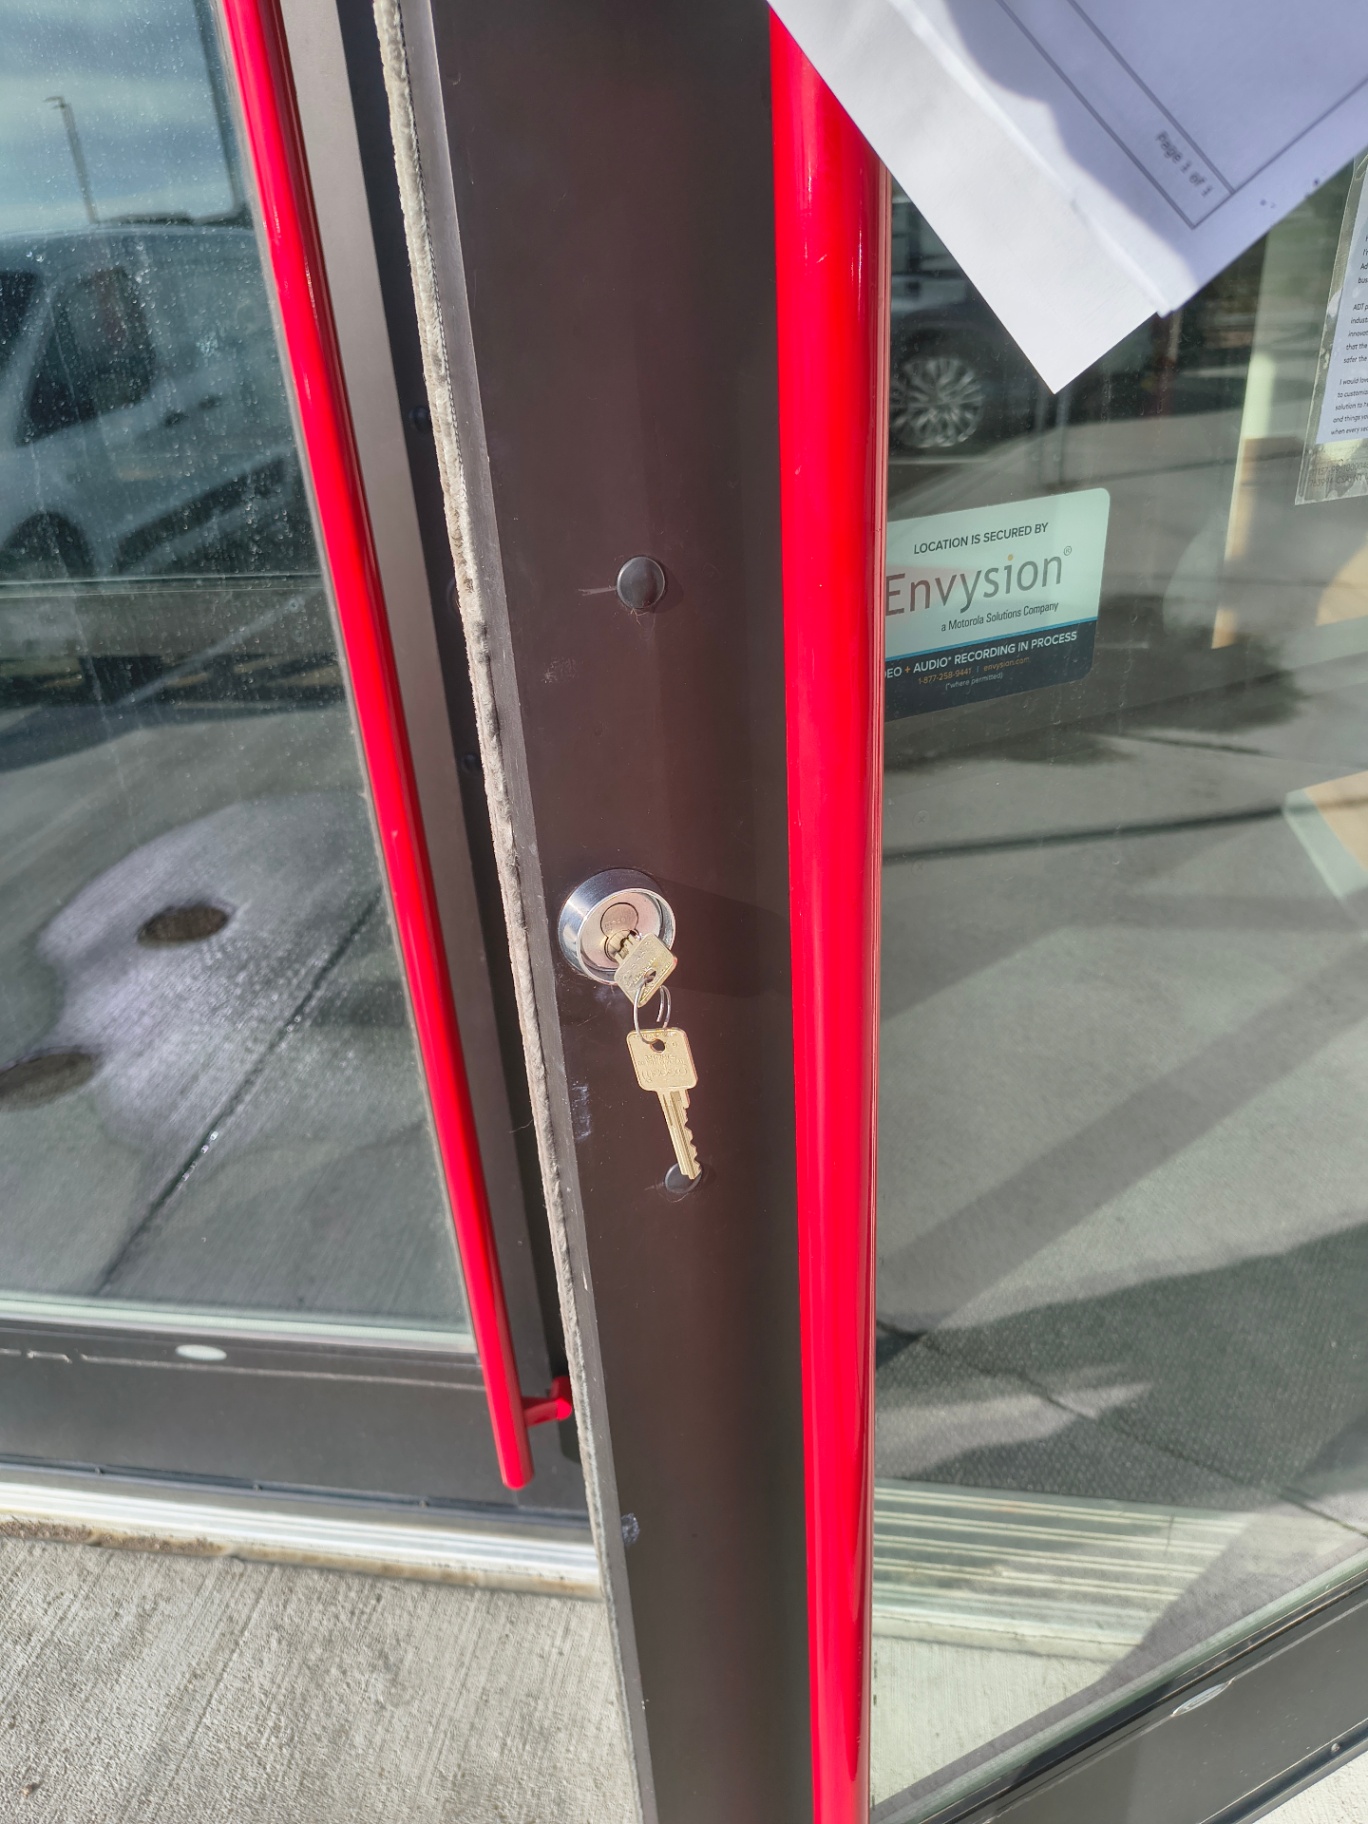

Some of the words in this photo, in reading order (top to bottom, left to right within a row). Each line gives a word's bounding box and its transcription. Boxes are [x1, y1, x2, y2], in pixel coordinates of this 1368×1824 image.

[1156, 131, 1183, 163] Page
[1189, 171, 1206, 187] of
[1346, 342, 1358, 350] that
[1359, 342, 1367, 350] the
[1343, 377, 1359, 385] would
[914, 535, 968, 555] LOCATION
[971, 534, 981, 546] IS
[983, 525, 1033, 542] SECURED
[1034, 521, 1049, 534] BY
[941, 623, 947, 632] a
[948, 613, 984, 631] Motorola
[986, 607, 1022, 623] Solutions
[1023, 601, 1060, 618] Company
[954, 643, 1016, 665] RECORDING
[1018, 640, 1029, 652] IN
[1031, 631, 1078, 650] PROCESS
[918, 667, 972, 685] 1-877-258-9441
[983, 656, 1030, 673] envysion.com
[971, 671, 1004, 686] permitted)
